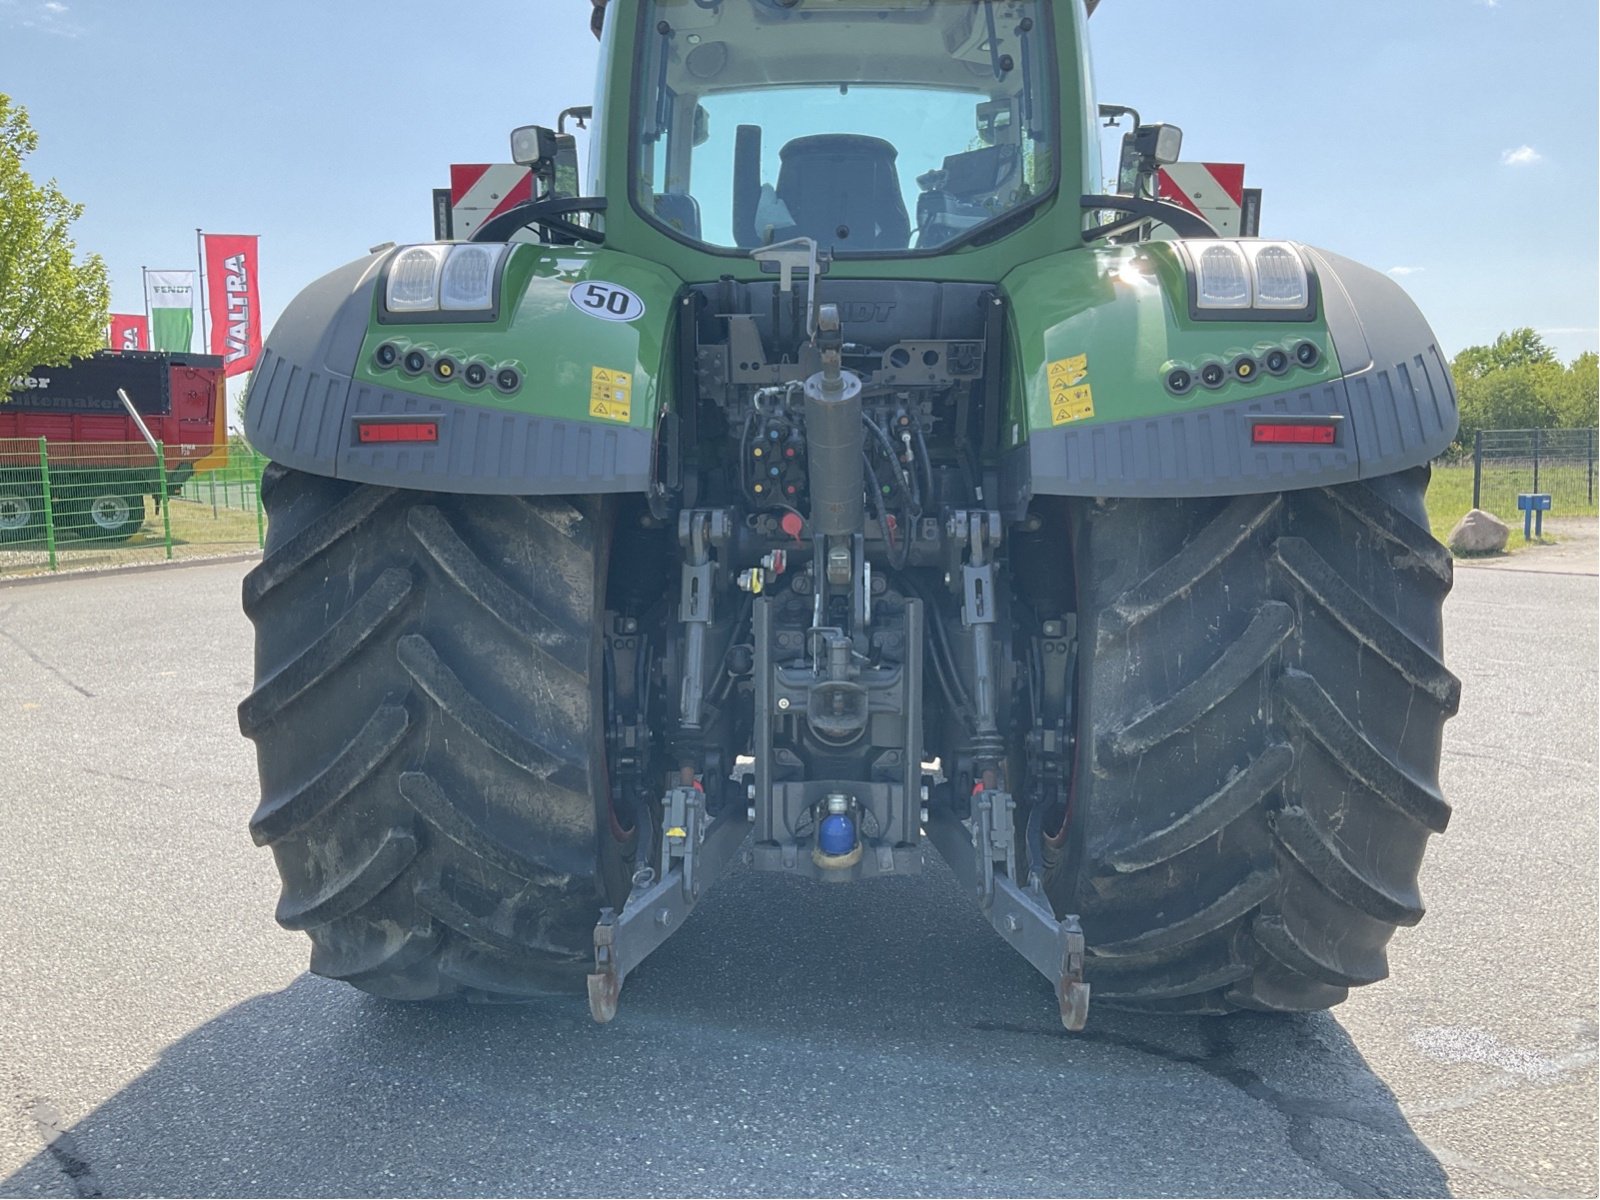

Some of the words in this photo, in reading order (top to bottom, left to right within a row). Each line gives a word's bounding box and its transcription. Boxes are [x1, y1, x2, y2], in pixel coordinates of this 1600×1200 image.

[153, 285, 191, 294] FENDT
[583, 284, 630, 315] 50
[224, 252, 249, 363] VALTRA
